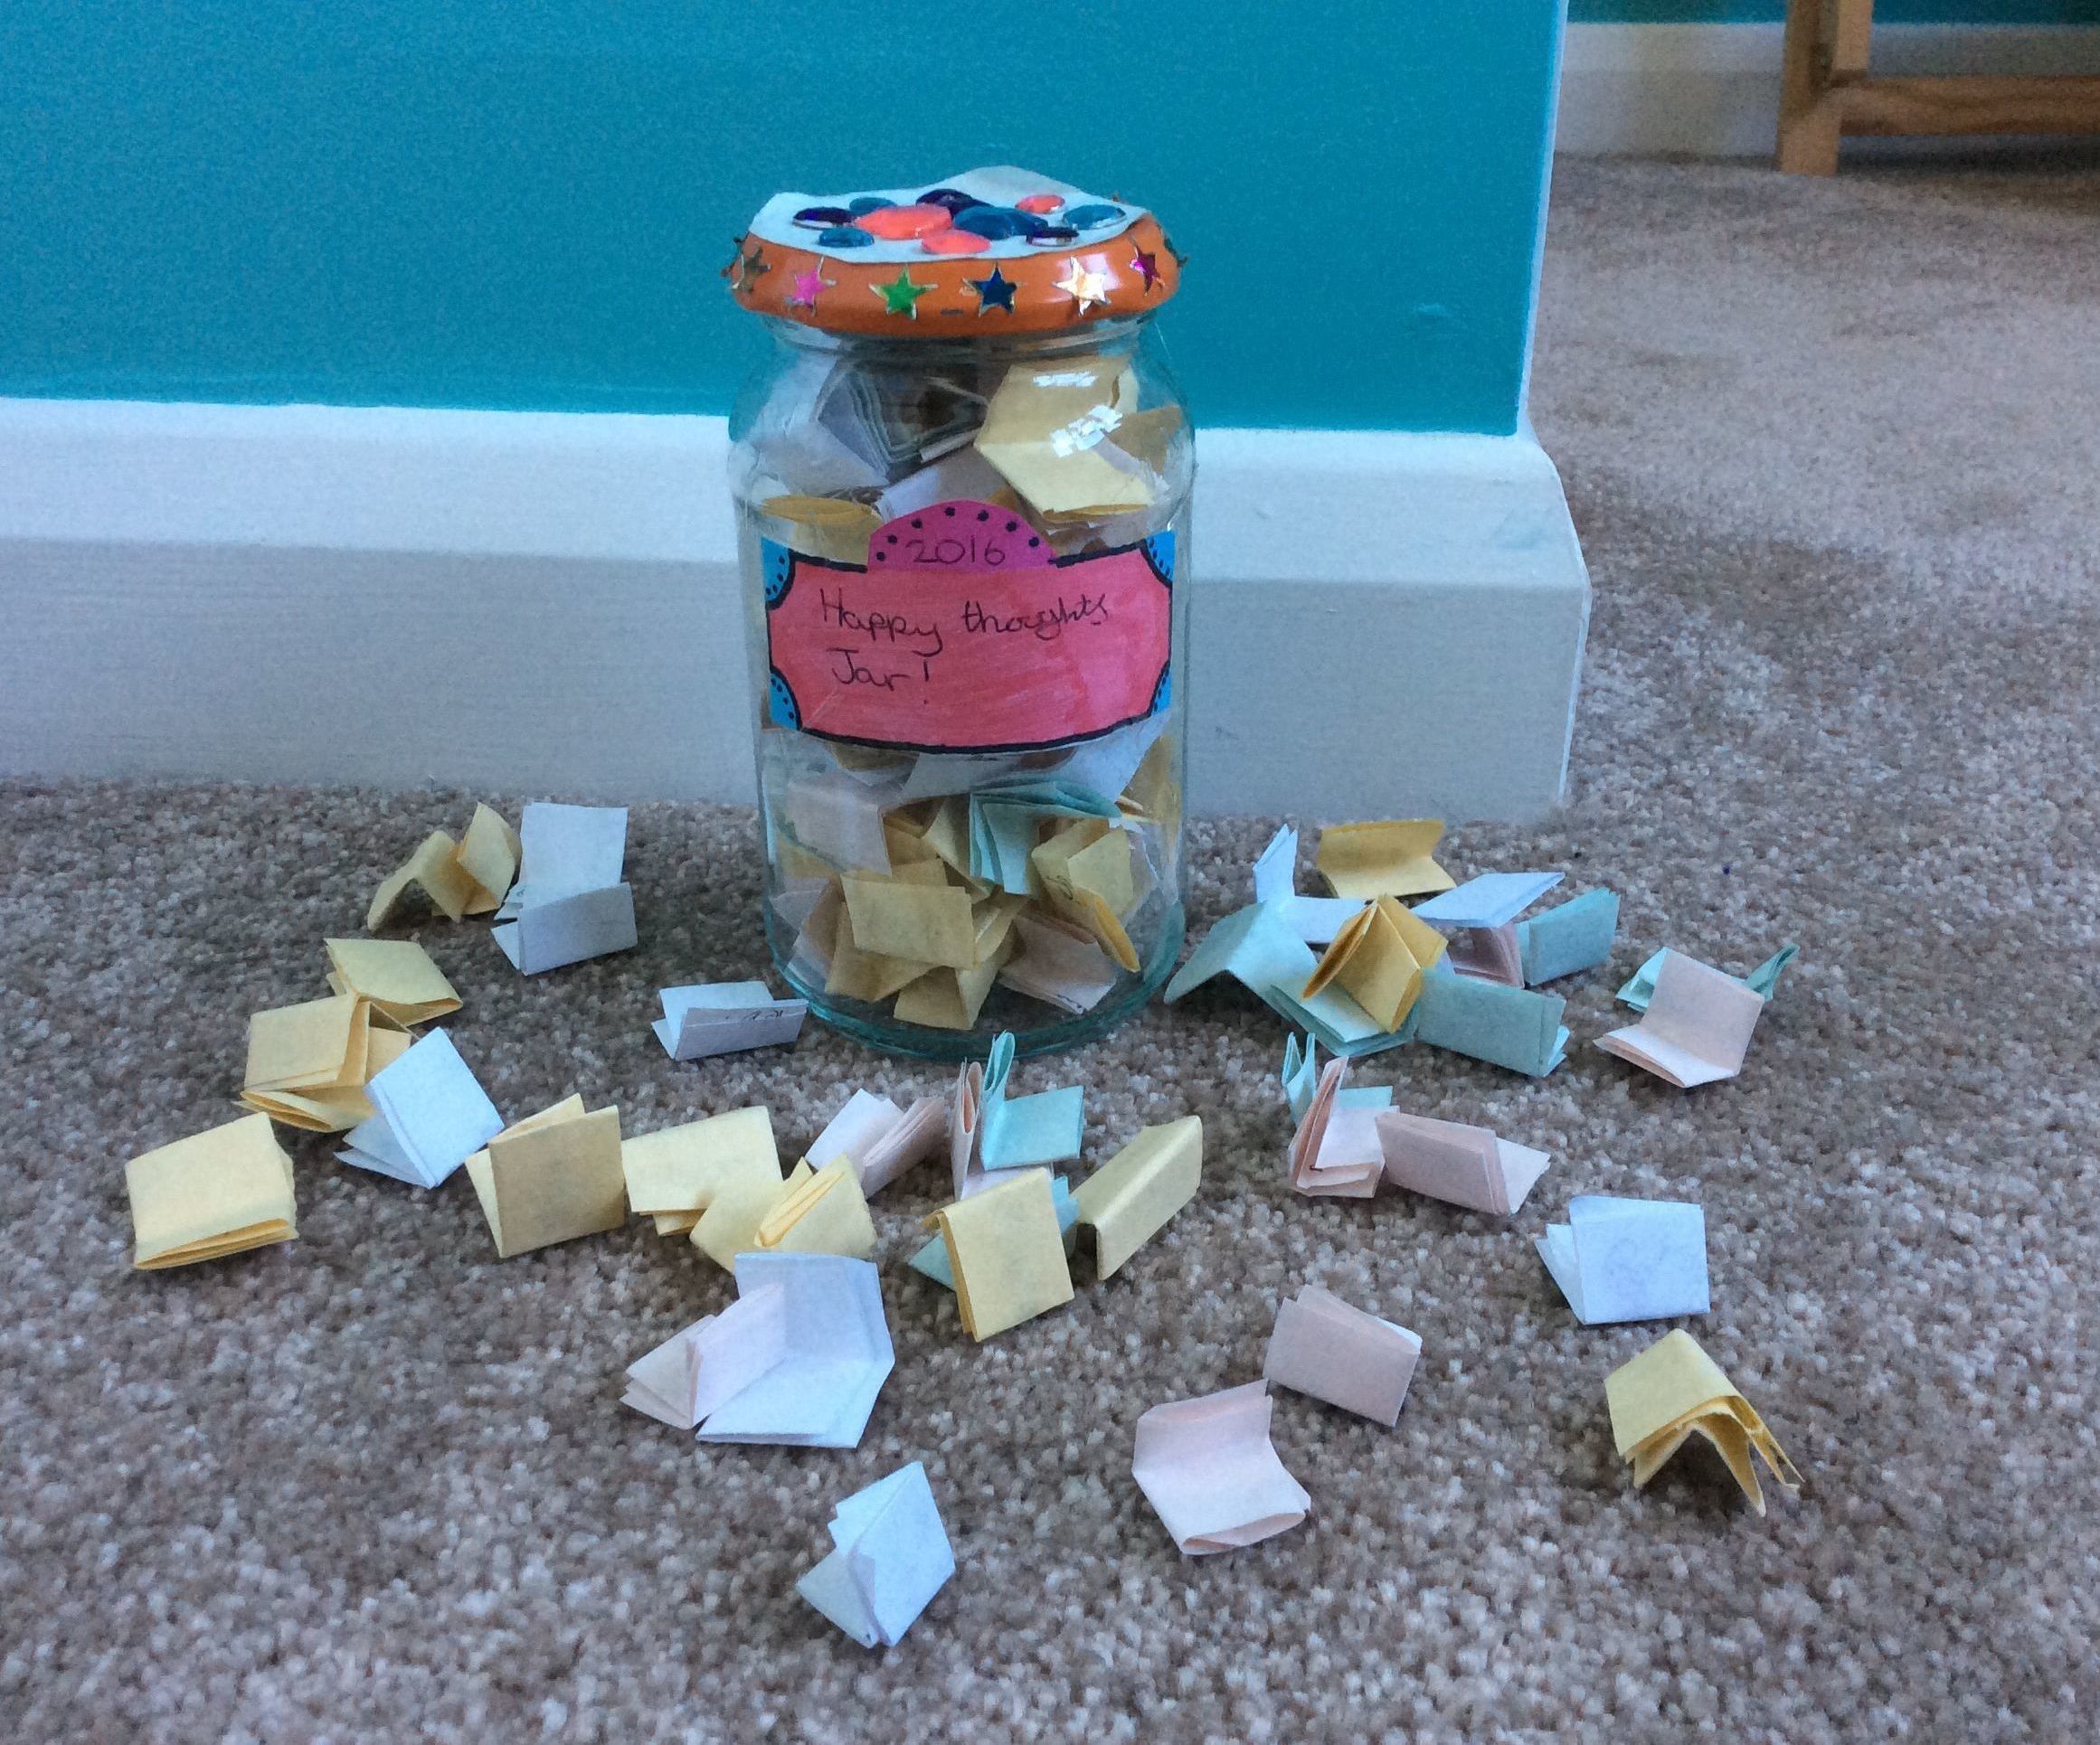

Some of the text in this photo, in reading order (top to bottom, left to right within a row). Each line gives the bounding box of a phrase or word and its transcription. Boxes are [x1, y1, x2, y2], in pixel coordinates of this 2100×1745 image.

[904, 535, 1007, 566] 2016
[818, 588, 1109, 657] Happy thoughts
[827, 648, 931, 705] Jar!
